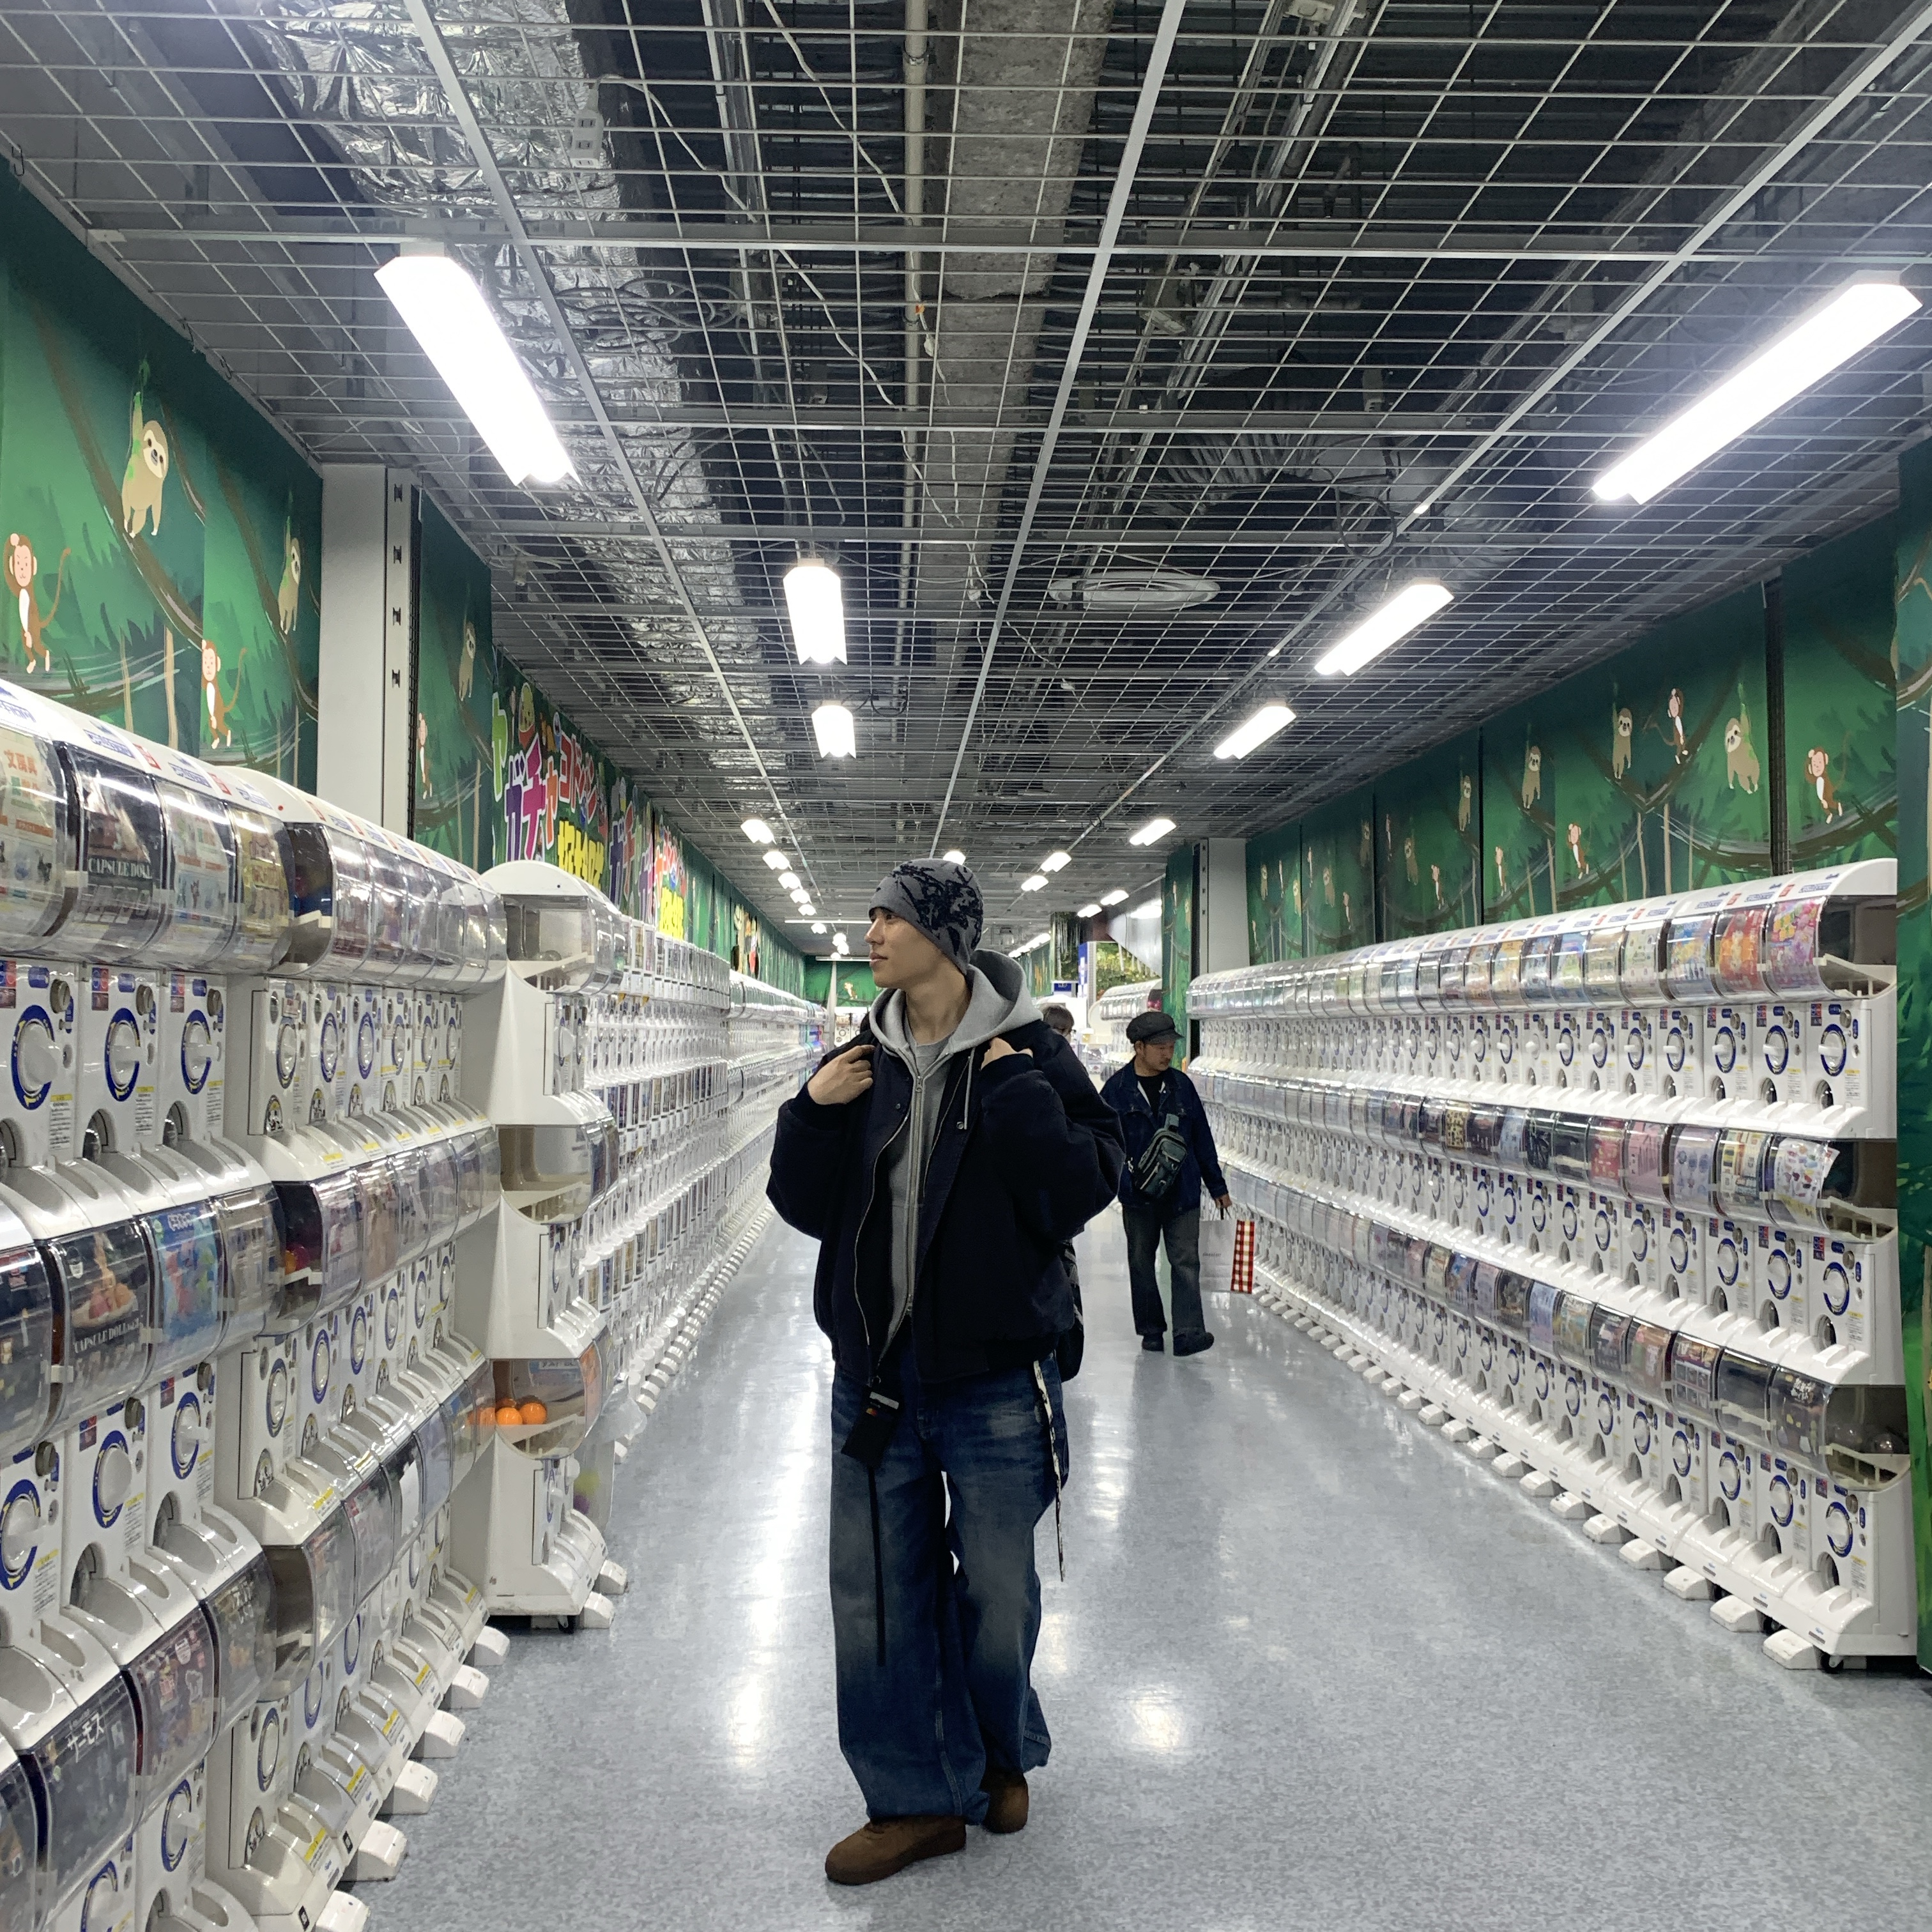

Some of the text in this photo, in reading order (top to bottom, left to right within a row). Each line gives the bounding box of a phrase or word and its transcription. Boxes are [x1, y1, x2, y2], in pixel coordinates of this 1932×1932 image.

[88, 857, 153, 879] CAPSULE DOLL
[67, 1712, 104, 1763] サーモス
